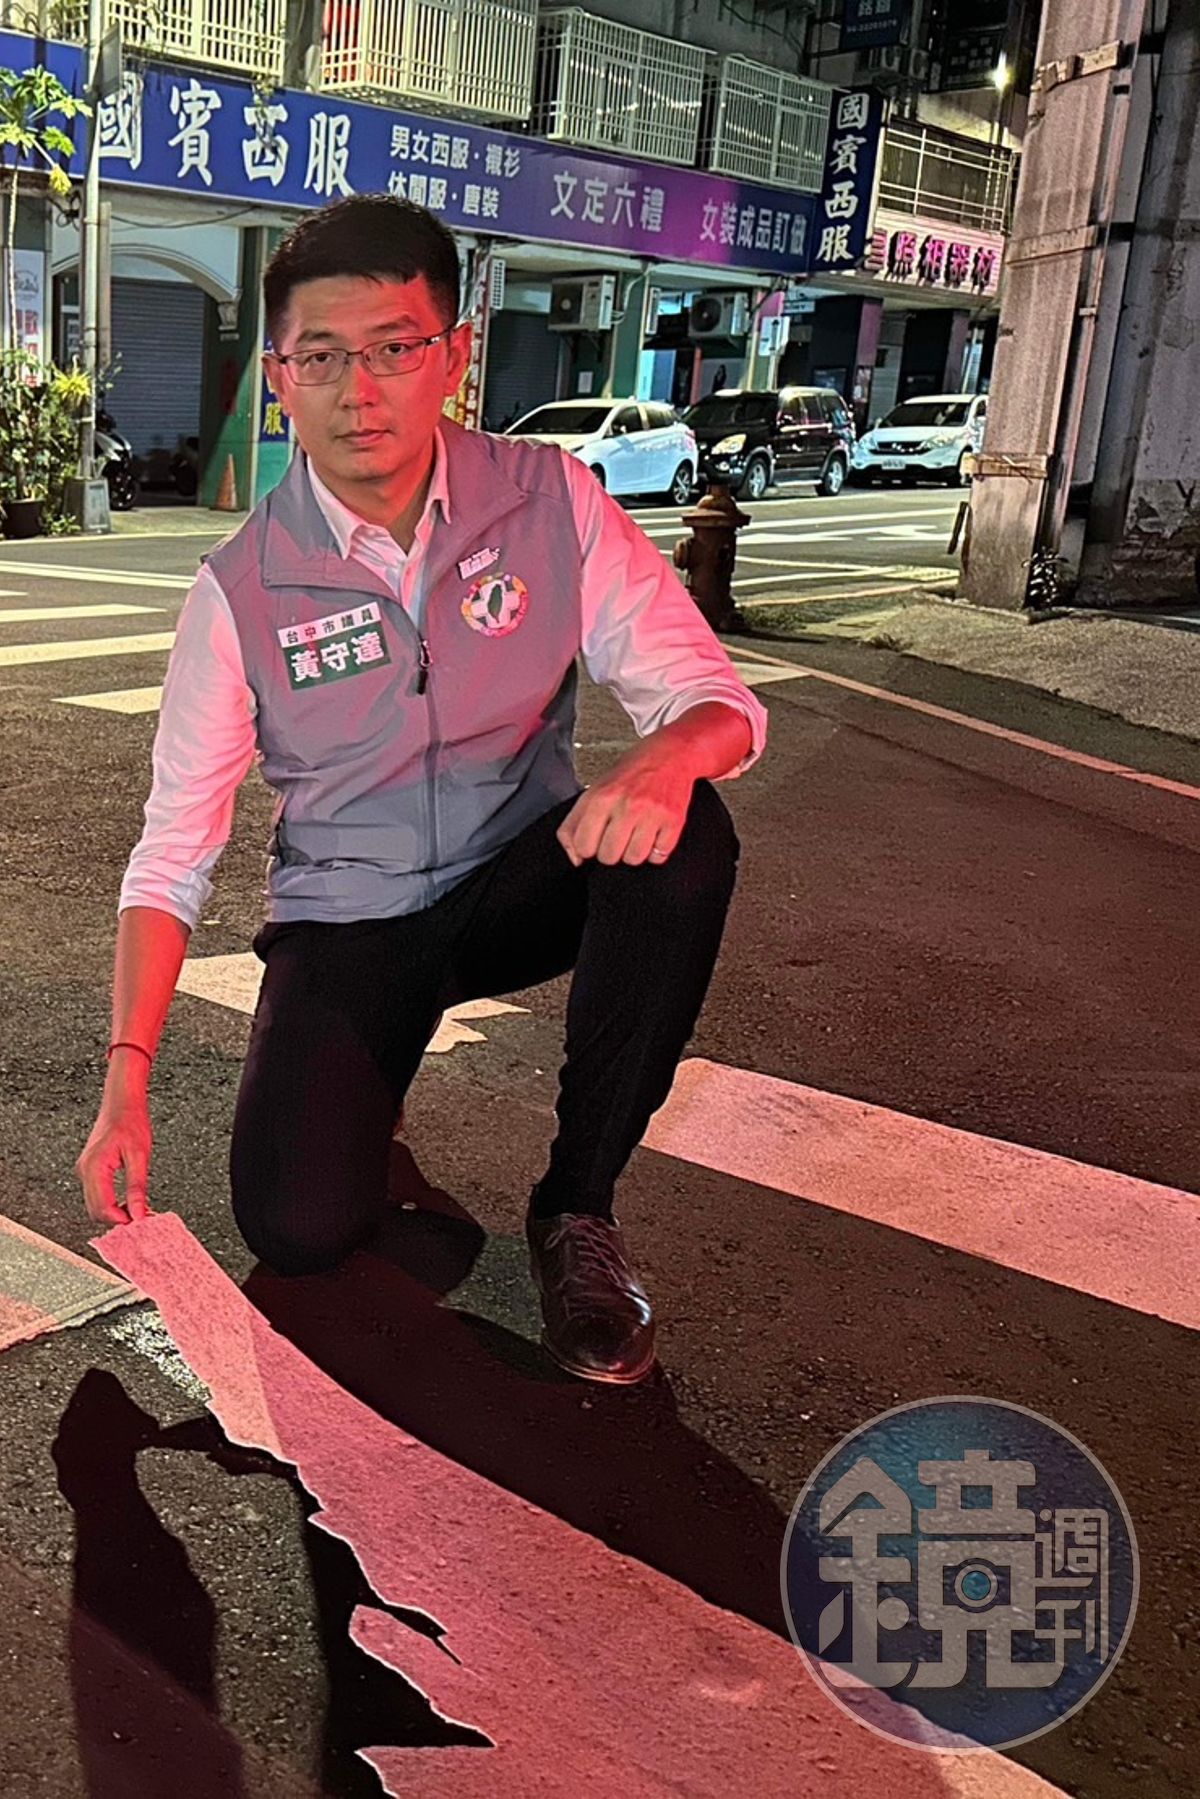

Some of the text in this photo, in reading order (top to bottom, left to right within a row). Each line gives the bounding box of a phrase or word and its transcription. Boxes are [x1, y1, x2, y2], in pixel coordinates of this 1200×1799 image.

[97, 71, 358, 198] 國賓西服
[550, 170, 666, 232] 文定六禮
[815, 92, 870, 263] 國賓西服
[865, 228, 996, 292] 照相器材
[286, 608, 374, 643] 台中市議員
[290, 631, 385, 682] 黃守達
